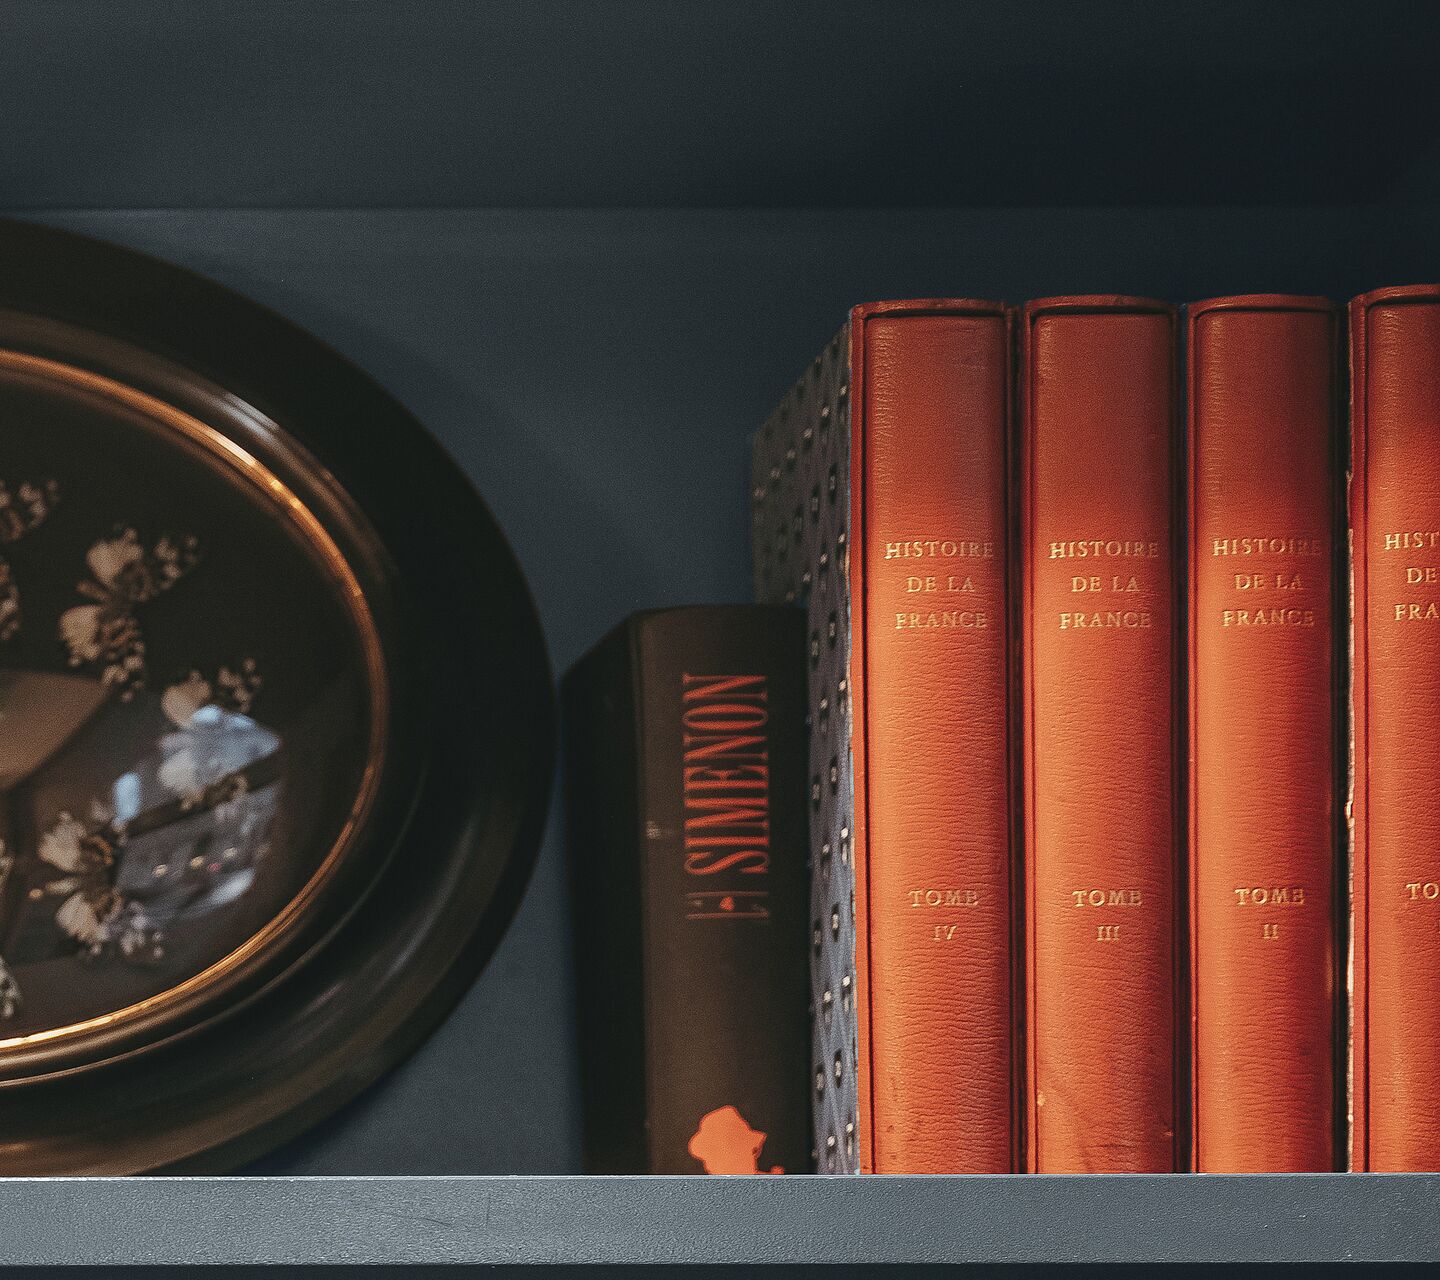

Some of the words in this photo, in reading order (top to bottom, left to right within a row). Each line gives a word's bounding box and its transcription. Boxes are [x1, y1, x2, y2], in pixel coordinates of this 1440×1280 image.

[884, 540, 994, 560] HISTOIRE
[1048, 540, 1159, 559] HISTOIRE
[1213, 538, 1322, 557] HISTOIRE
[906, 576, 936, 593] DE
[948, 575, 975, 592] LA
[1071, 576, 1102, 592] DE
[1113, 575, 1140, 592] LA
[1234, 574, 1264, 590] DE
[1276, 574, 1304, 590] LA
[895, 611, 987, 629] FRANCE
[1059, 611, 1153, 629] FRANCE
[1222, 609, 1313, 627] FRANCE
[682, 673, 769, 874] SIMENON
[908, 888, 978, 908] TOME
[1072, 889, 1142, 907] TOME
[1234, 887, 1304, 906] TOME
[933, 924, 957, 941] IV
[1097, 924, 1119, 941] III
[1262, 923, 1279, 939] II
